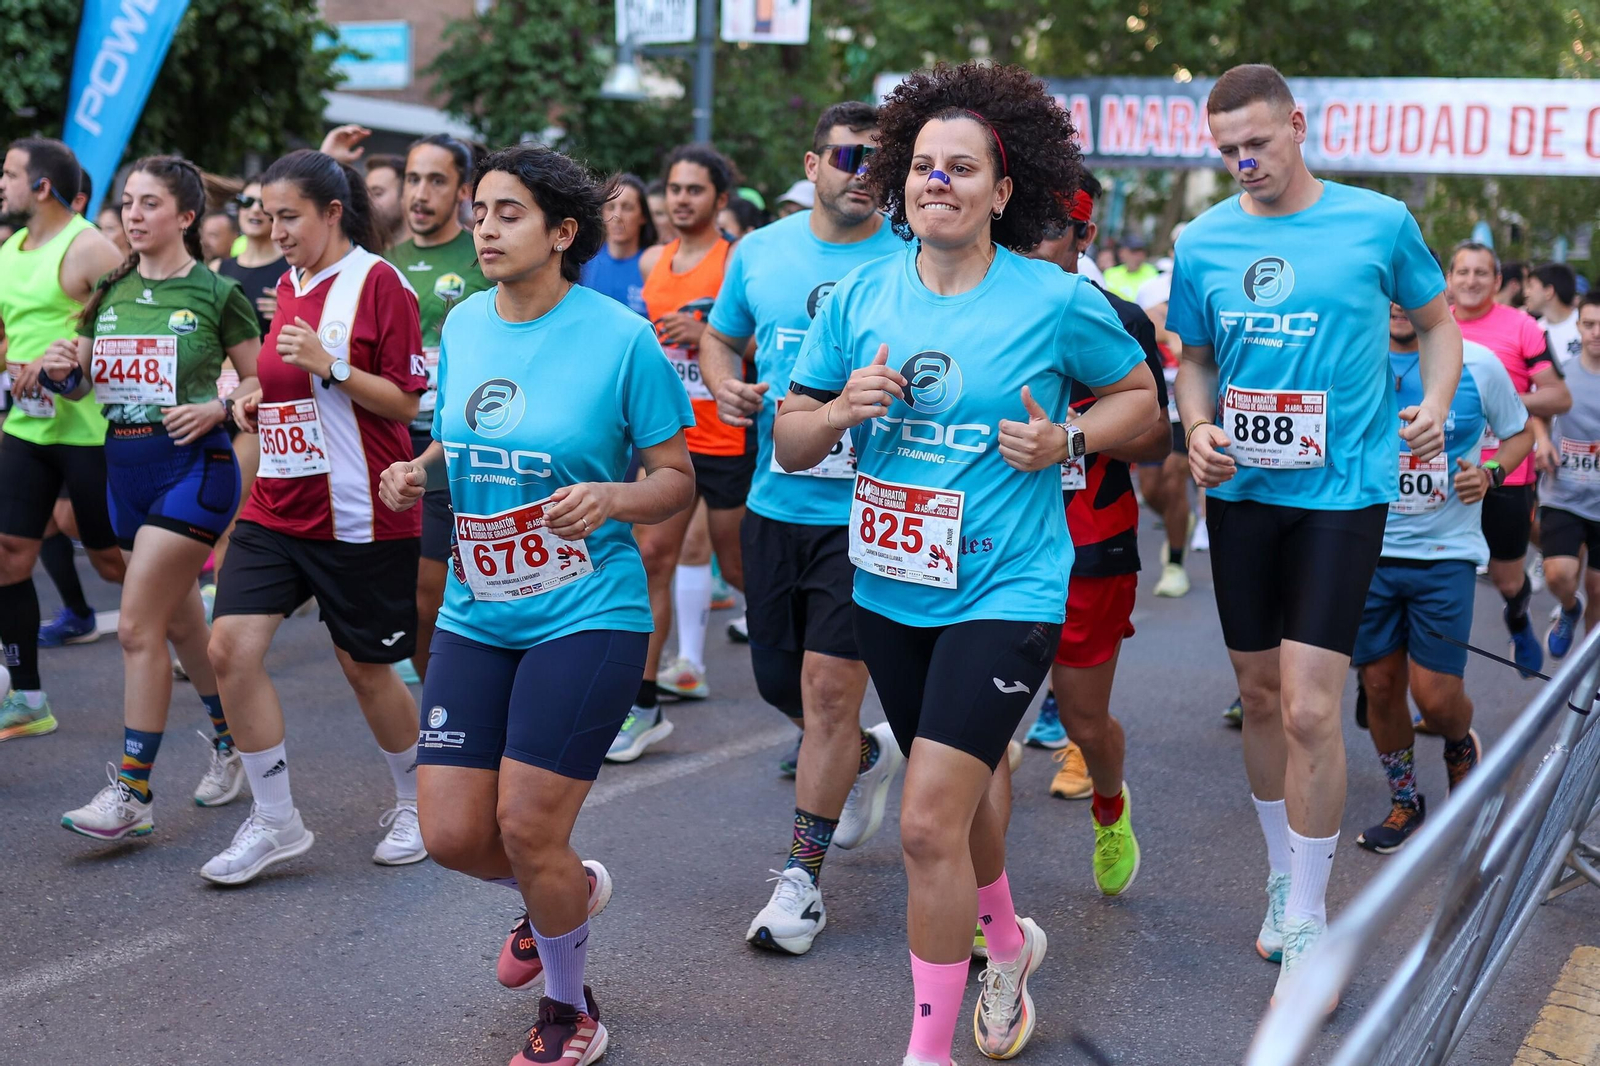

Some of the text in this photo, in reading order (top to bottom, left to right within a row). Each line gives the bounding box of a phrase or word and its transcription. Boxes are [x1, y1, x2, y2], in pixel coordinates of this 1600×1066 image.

[1322, 102, 1489, 157] CIUDAD
[1507, 105, 1569, 160] DE
[1219, 310, 1319, 336] FDC
[1243, 337, 1284, 348] TRAINING
[94, 359, 160, 384] 2448
[671, 362, 700, 382] 96
[1228, 390, 1238, 408] 41
[114, 426, 153, 436] WONG
[871, 415, 990, 454] FDC
[1234, 413, 1294, 445] 888
[261, 426, 307, 455] 3508
[442, 440, 552, 478] FDC
[897, 447, 946, 464] TRAINING
[470, 474, 517, 486] TRAINING
[880, 489, 907, 502] MARATÓN
[884, 499, 906, 511] GRANADA
[914, 503, 921, 512] 26
[936, 506, 949, 515] 2025
[459, 519, 473, 539] 41
[486, 516, 516, 531] MARATÓN
[487, 531, 494, 539] DE
[494, 527, 518, 538] GRANADA
[526, 521, 533, 530] 26
[860, 507, 924, 554] 825
[473, 533, 549, 577] 678
[958, 535, 993, 557] les
